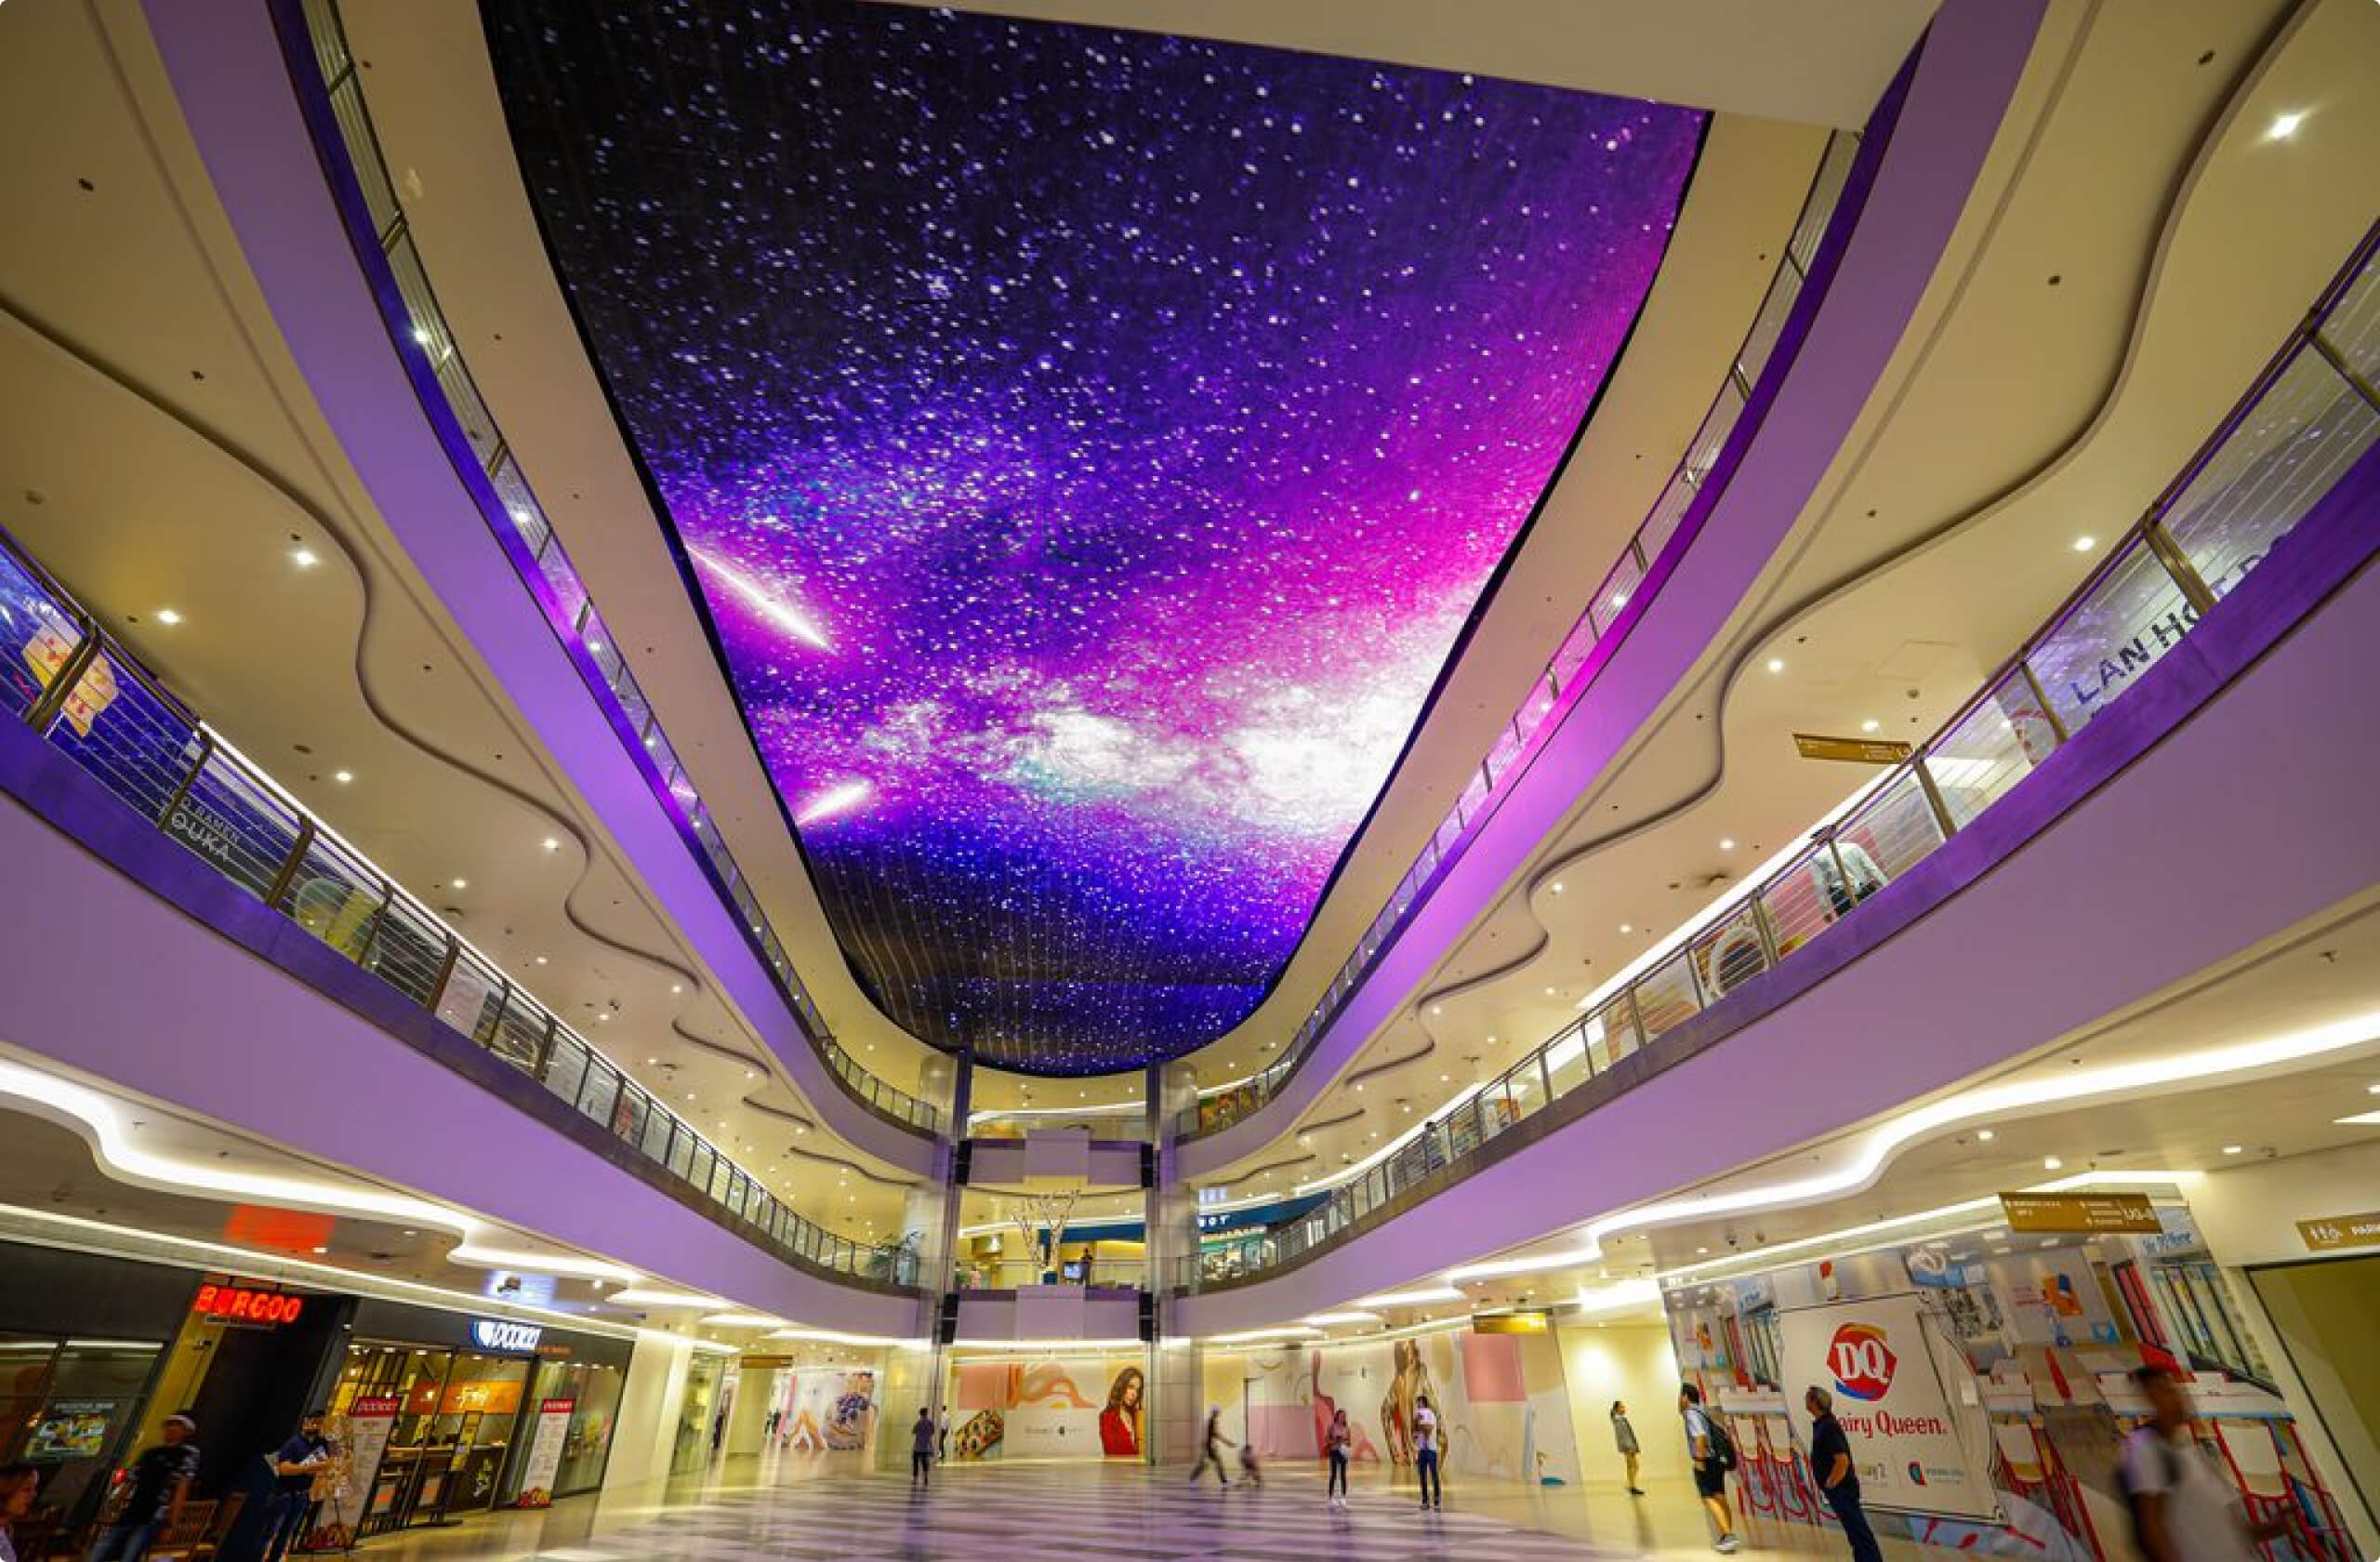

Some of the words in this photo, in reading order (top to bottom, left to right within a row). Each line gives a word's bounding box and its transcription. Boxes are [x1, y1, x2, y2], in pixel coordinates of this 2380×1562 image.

[2070, 638, 2150, 704] LAN
[1837, 1341, 1890, 1383] DQ
[1837, 1413, 1872, 1438] airy
